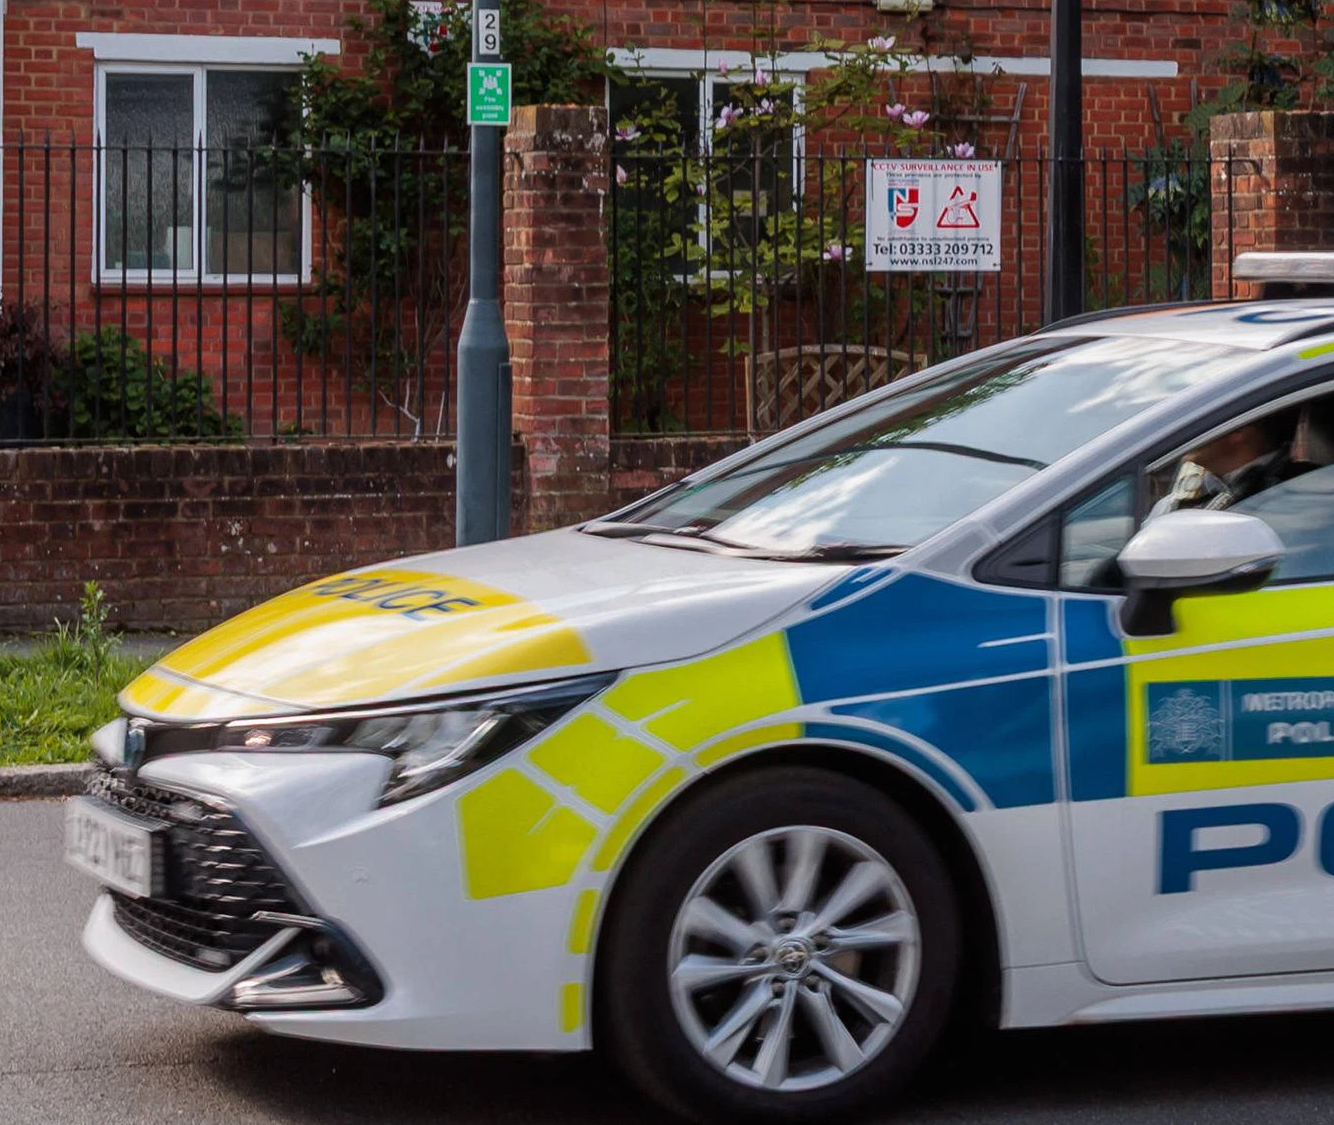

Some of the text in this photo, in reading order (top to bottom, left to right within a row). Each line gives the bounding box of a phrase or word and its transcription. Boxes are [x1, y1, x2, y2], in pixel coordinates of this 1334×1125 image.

[873, 163, 993, 171] CCTV SURVEILLANCE IN USE
[873, 243, 994, 255] Tel: 03333 209 712
